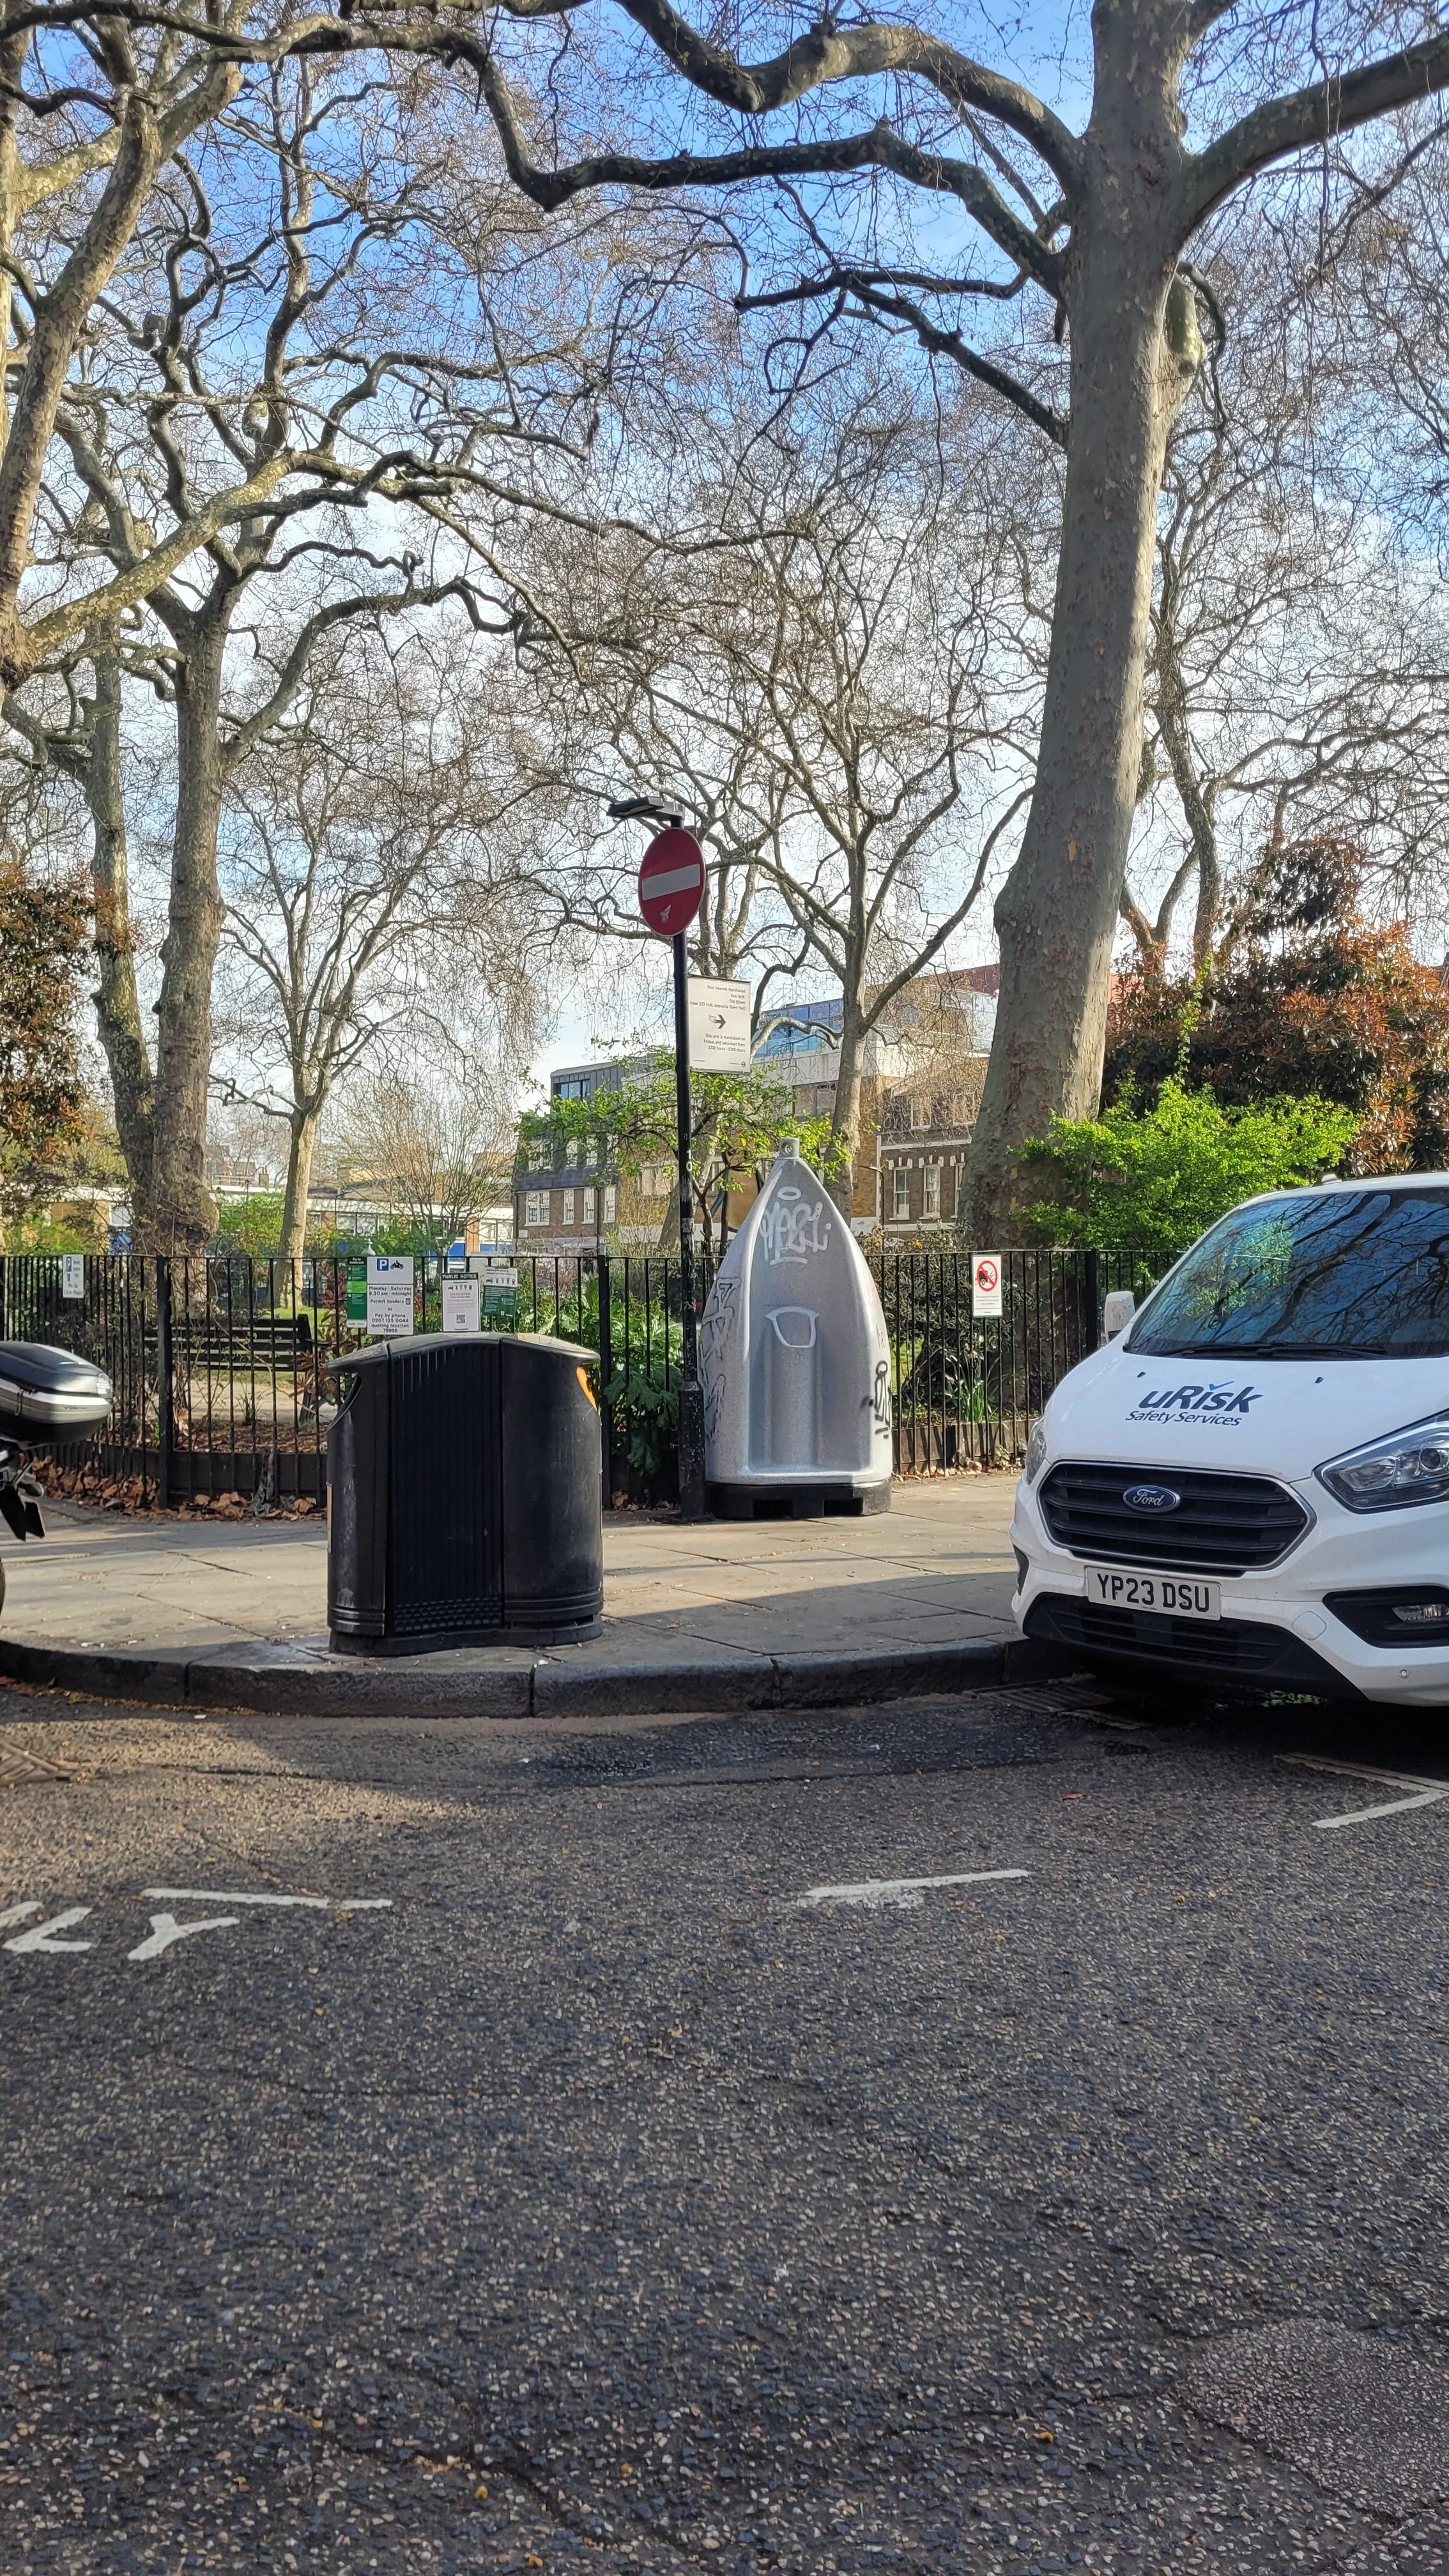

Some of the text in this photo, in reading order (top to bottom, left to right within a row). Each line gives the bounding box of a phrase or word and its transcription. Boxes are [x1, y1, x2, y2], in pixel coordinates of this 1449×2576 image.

[379, 1259, 388, 1270] P
[1138, 1381, 1264, 1413] uRisk
[1125, 1410, 1243, 1426] Safety Services
[1133, 1489, 1165, 1506] Ford
[1097, 1572, 1209, 1613] YP23 DSU
